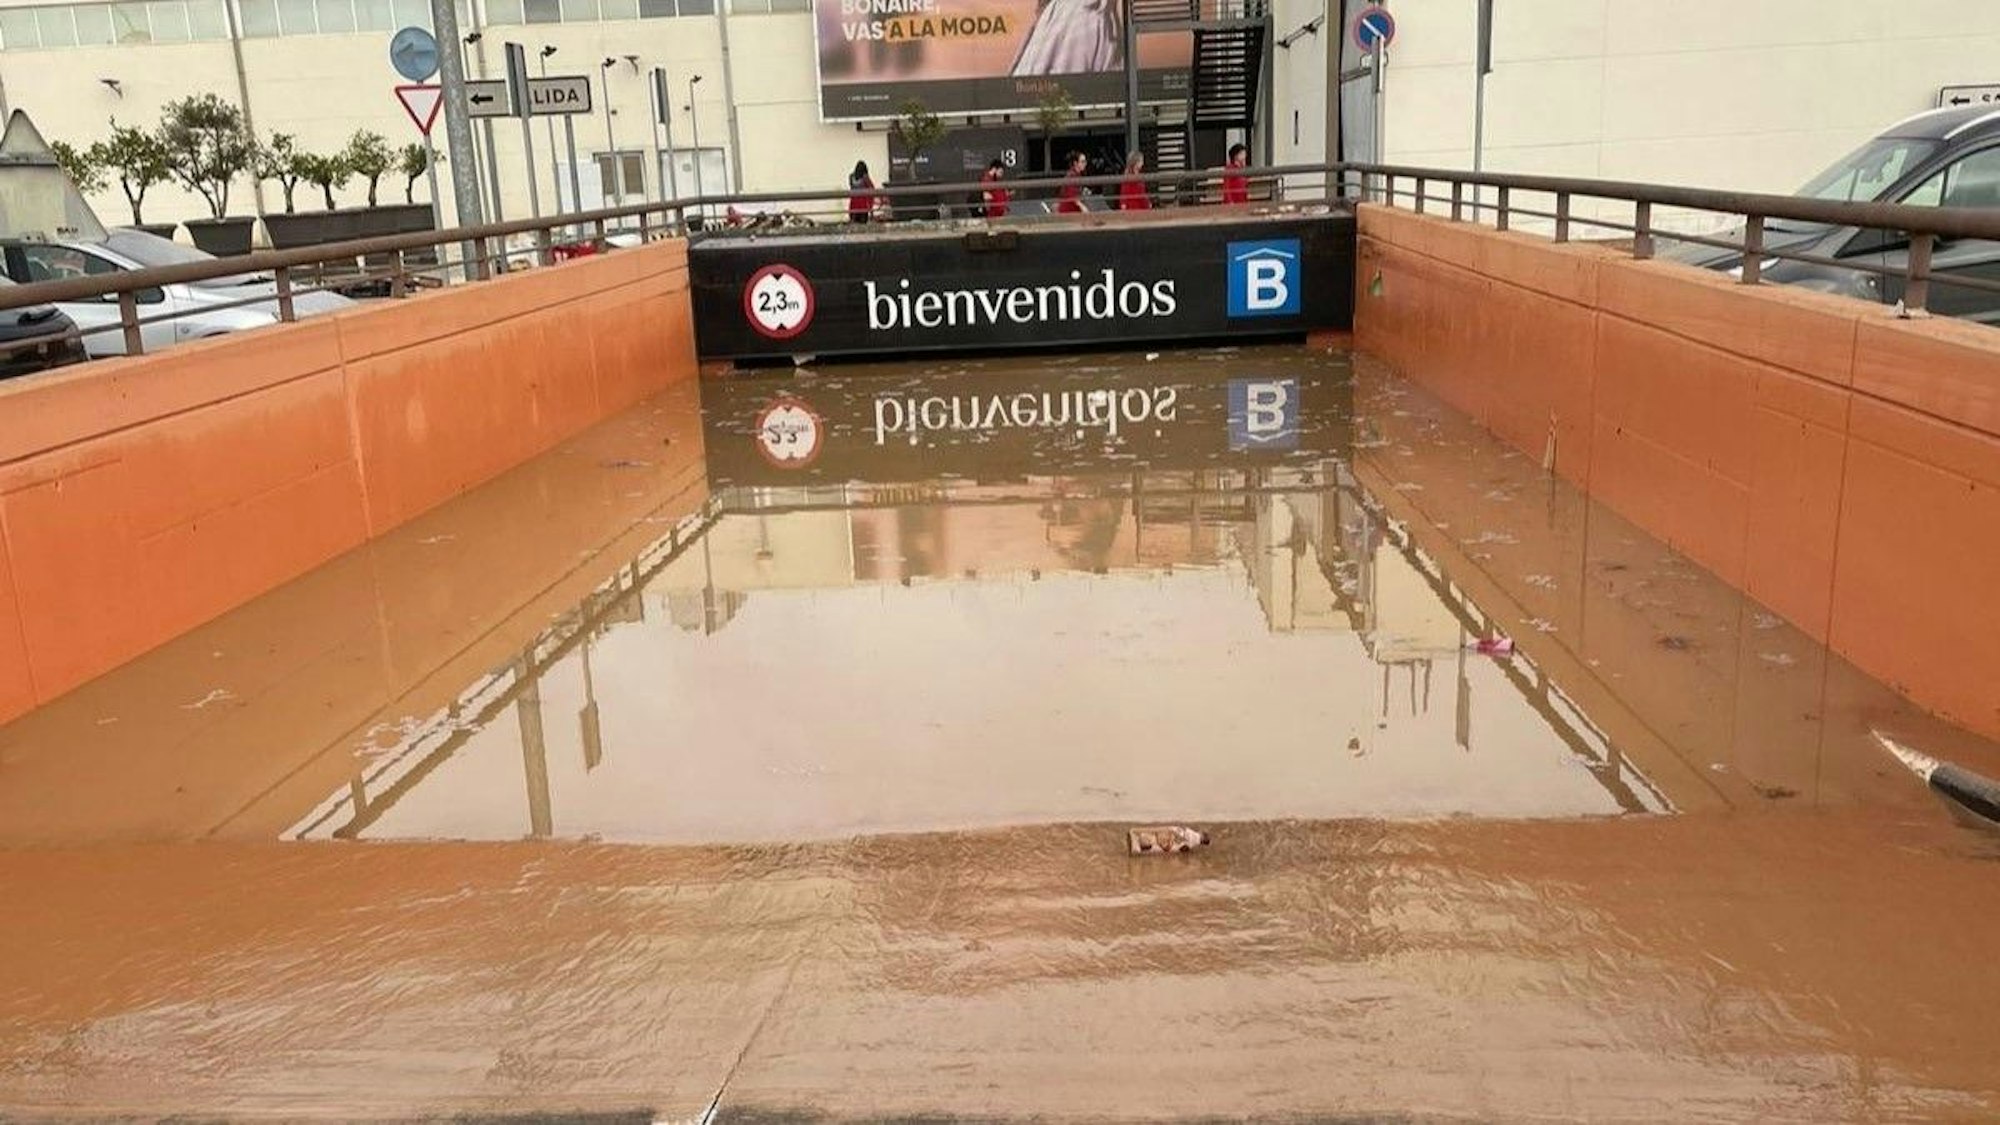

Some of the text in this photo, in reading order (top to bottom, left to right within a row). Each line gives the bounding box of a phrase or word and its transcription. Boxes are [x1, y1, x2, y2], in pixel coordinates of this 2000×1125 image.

[842, 15, 1008, 41] VAS A LA MODA
[532, 89, 580, 105] LIDA
[1247, 258, 1289, 311] B
[758, 290, 800, 314] 2,3m
[864, 268, 1177, 330] bienvenidos
